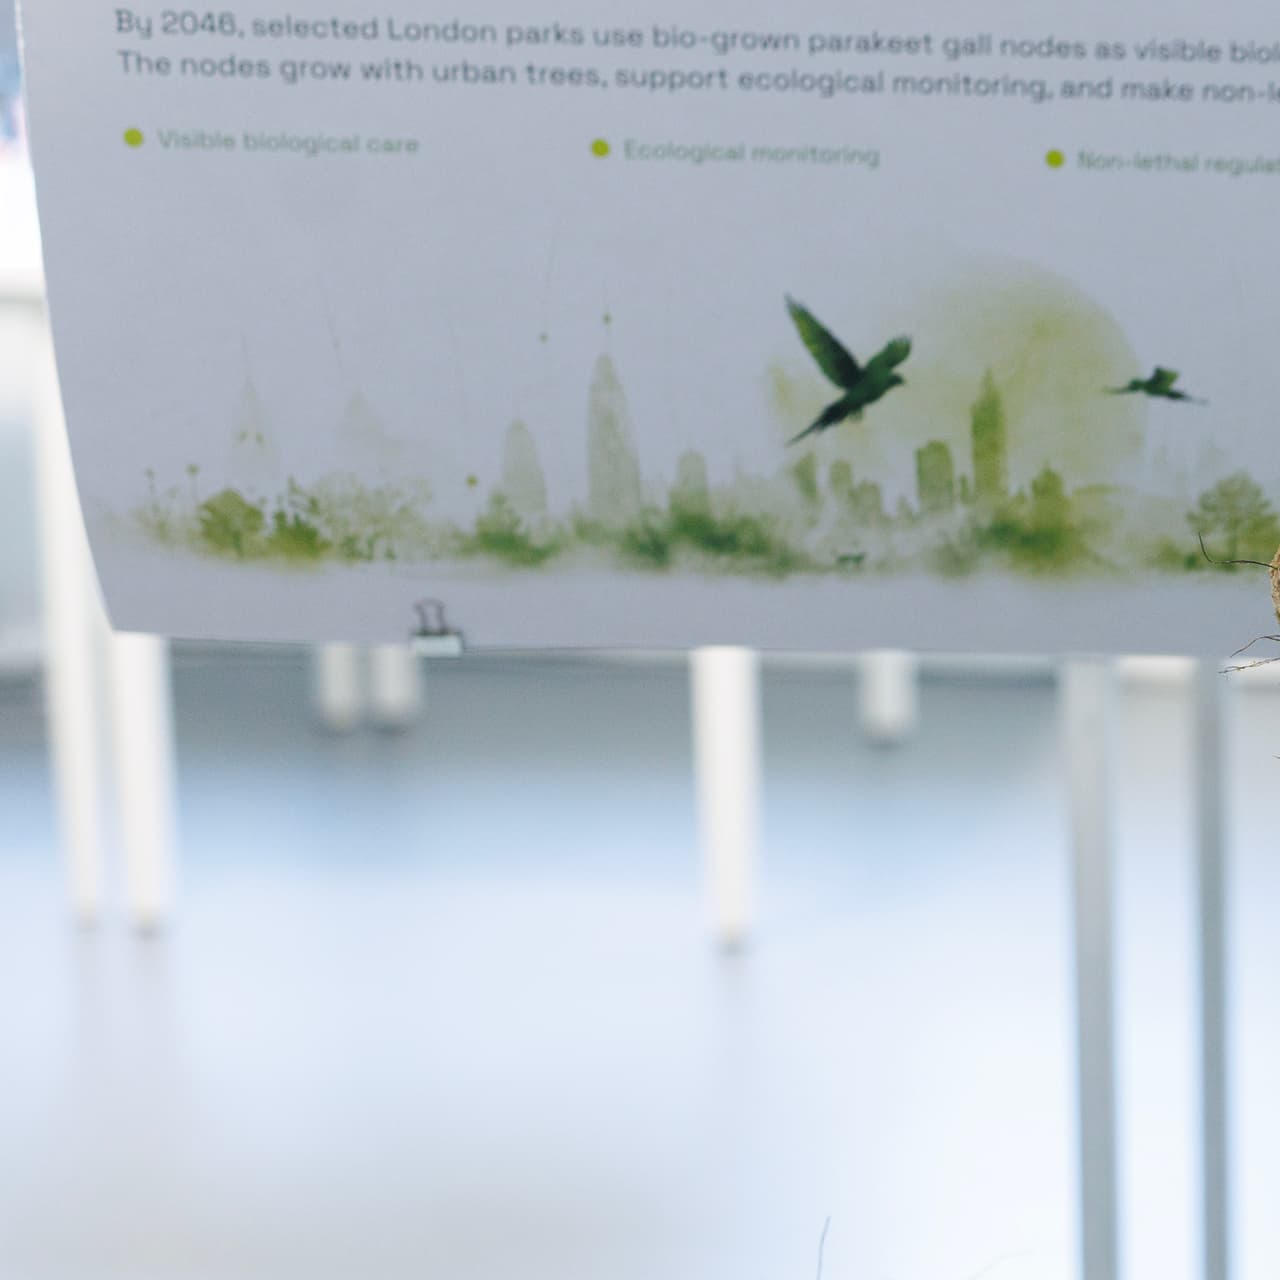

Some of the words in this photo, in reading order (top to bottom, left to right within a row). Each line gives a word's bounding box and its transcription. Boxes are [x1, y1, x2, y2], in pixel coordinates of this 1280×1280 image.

[115, 11, 152, 42] By
[162, 12, 244, 40] 2046,
[252, 14, 378, 39] selected
[386, 17, 496, 42] London
[506, 20, 584, 52] parks
[592, 27, 643, 46] use
[652, 23, 800, 57] bio-grown
[808, 27, 932, 60] parakeet
[942, 31, 992, 62] gall
[999, 32, 1087, 57] nodes
[1094, 40, 1127, 58] as
[1133, 36, 1222, 61] visible
[118, 50, 170, 74] The
[180, 52, 271, 77] nodes
[279, 60, 350, 87] grow
[360, 57, 423, 82] with
[432, 59, 516, 84] urban
[525, 64, 608, 90] trees,
[615, 67, 728, 97] support
[737, 68, 884, 102] ecological
[892, 72, 1054, 106] monitoring,
[1060, 76, 1113, 100] and
[1120, 78, 1194, 102] make
[157, 129, 236, 149] Visible
[242, 131, 360, 158] biological
[366, 139, 419, 154] care
[624, 141, 745, 168] Ecological
[751, 144, 880, 172] monitoring
[1077, 150, 1198, 171] Non-lethal
